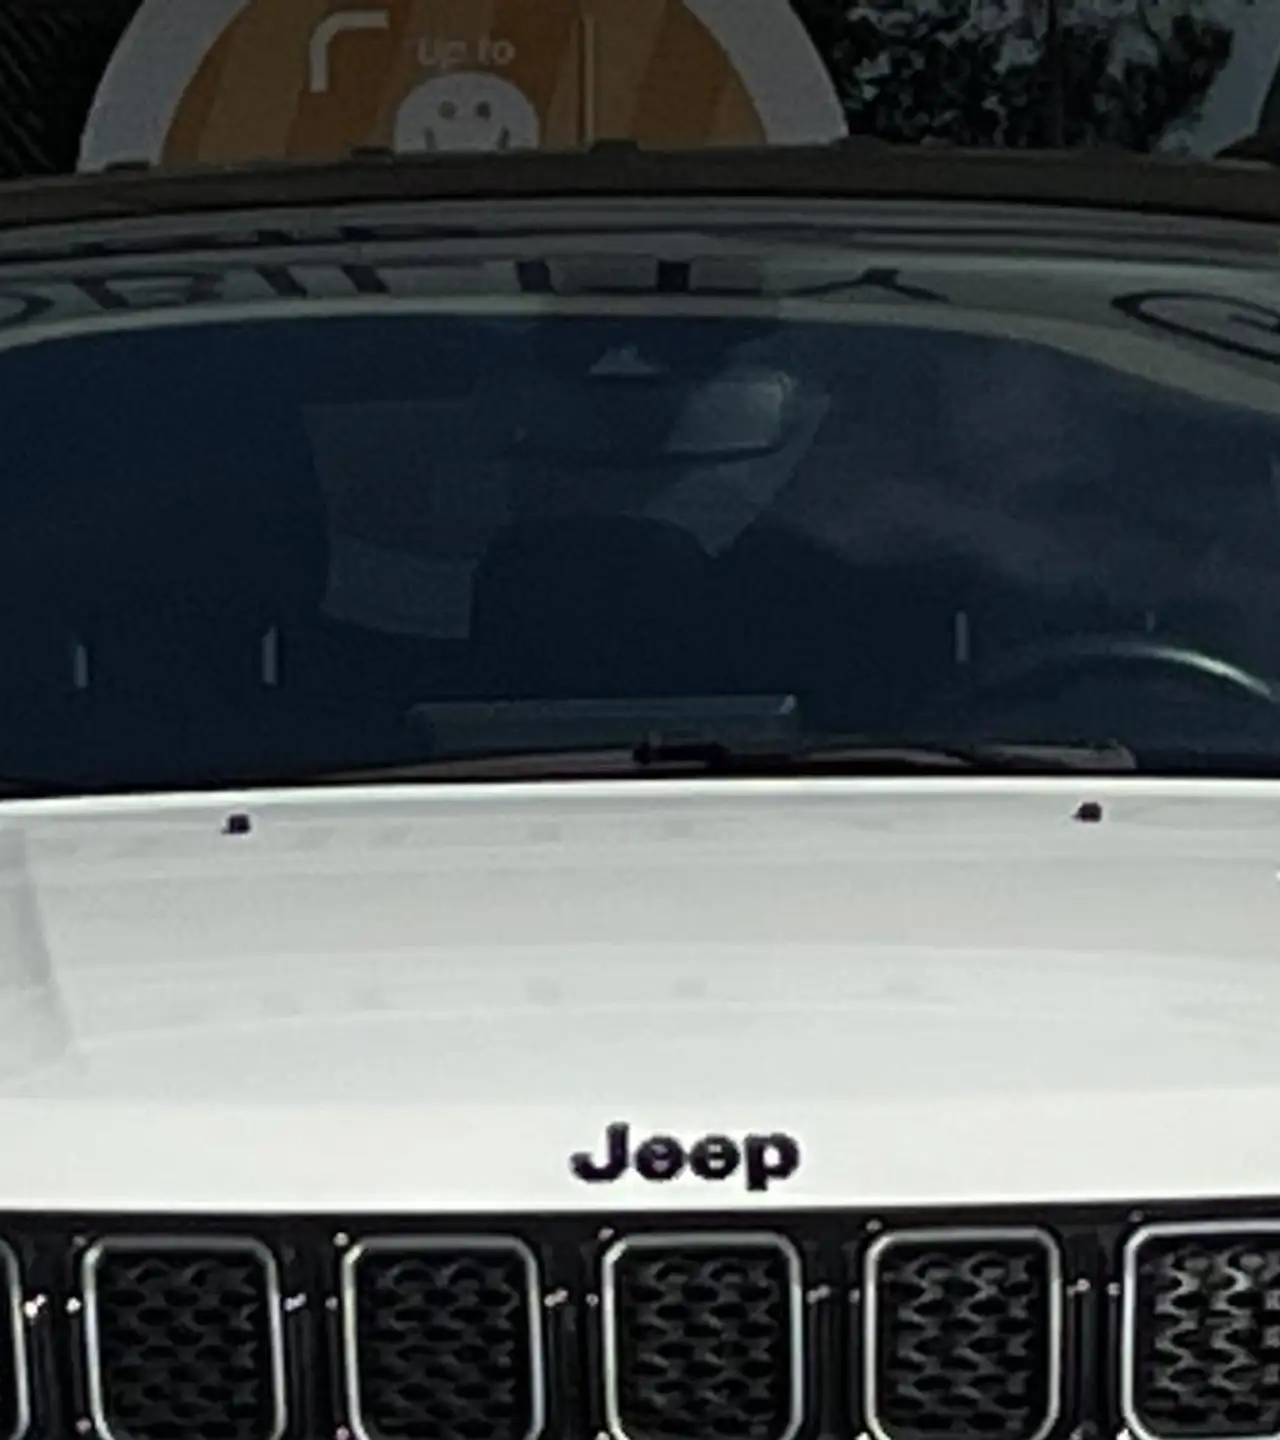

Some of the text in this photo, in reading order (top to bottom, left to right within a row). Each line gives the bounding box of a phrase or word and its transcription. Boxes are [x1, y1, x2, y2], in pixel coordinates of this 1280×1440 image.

[417, 37, 516, 70] up to
[568, 1120, 800, 1192] Jeep
